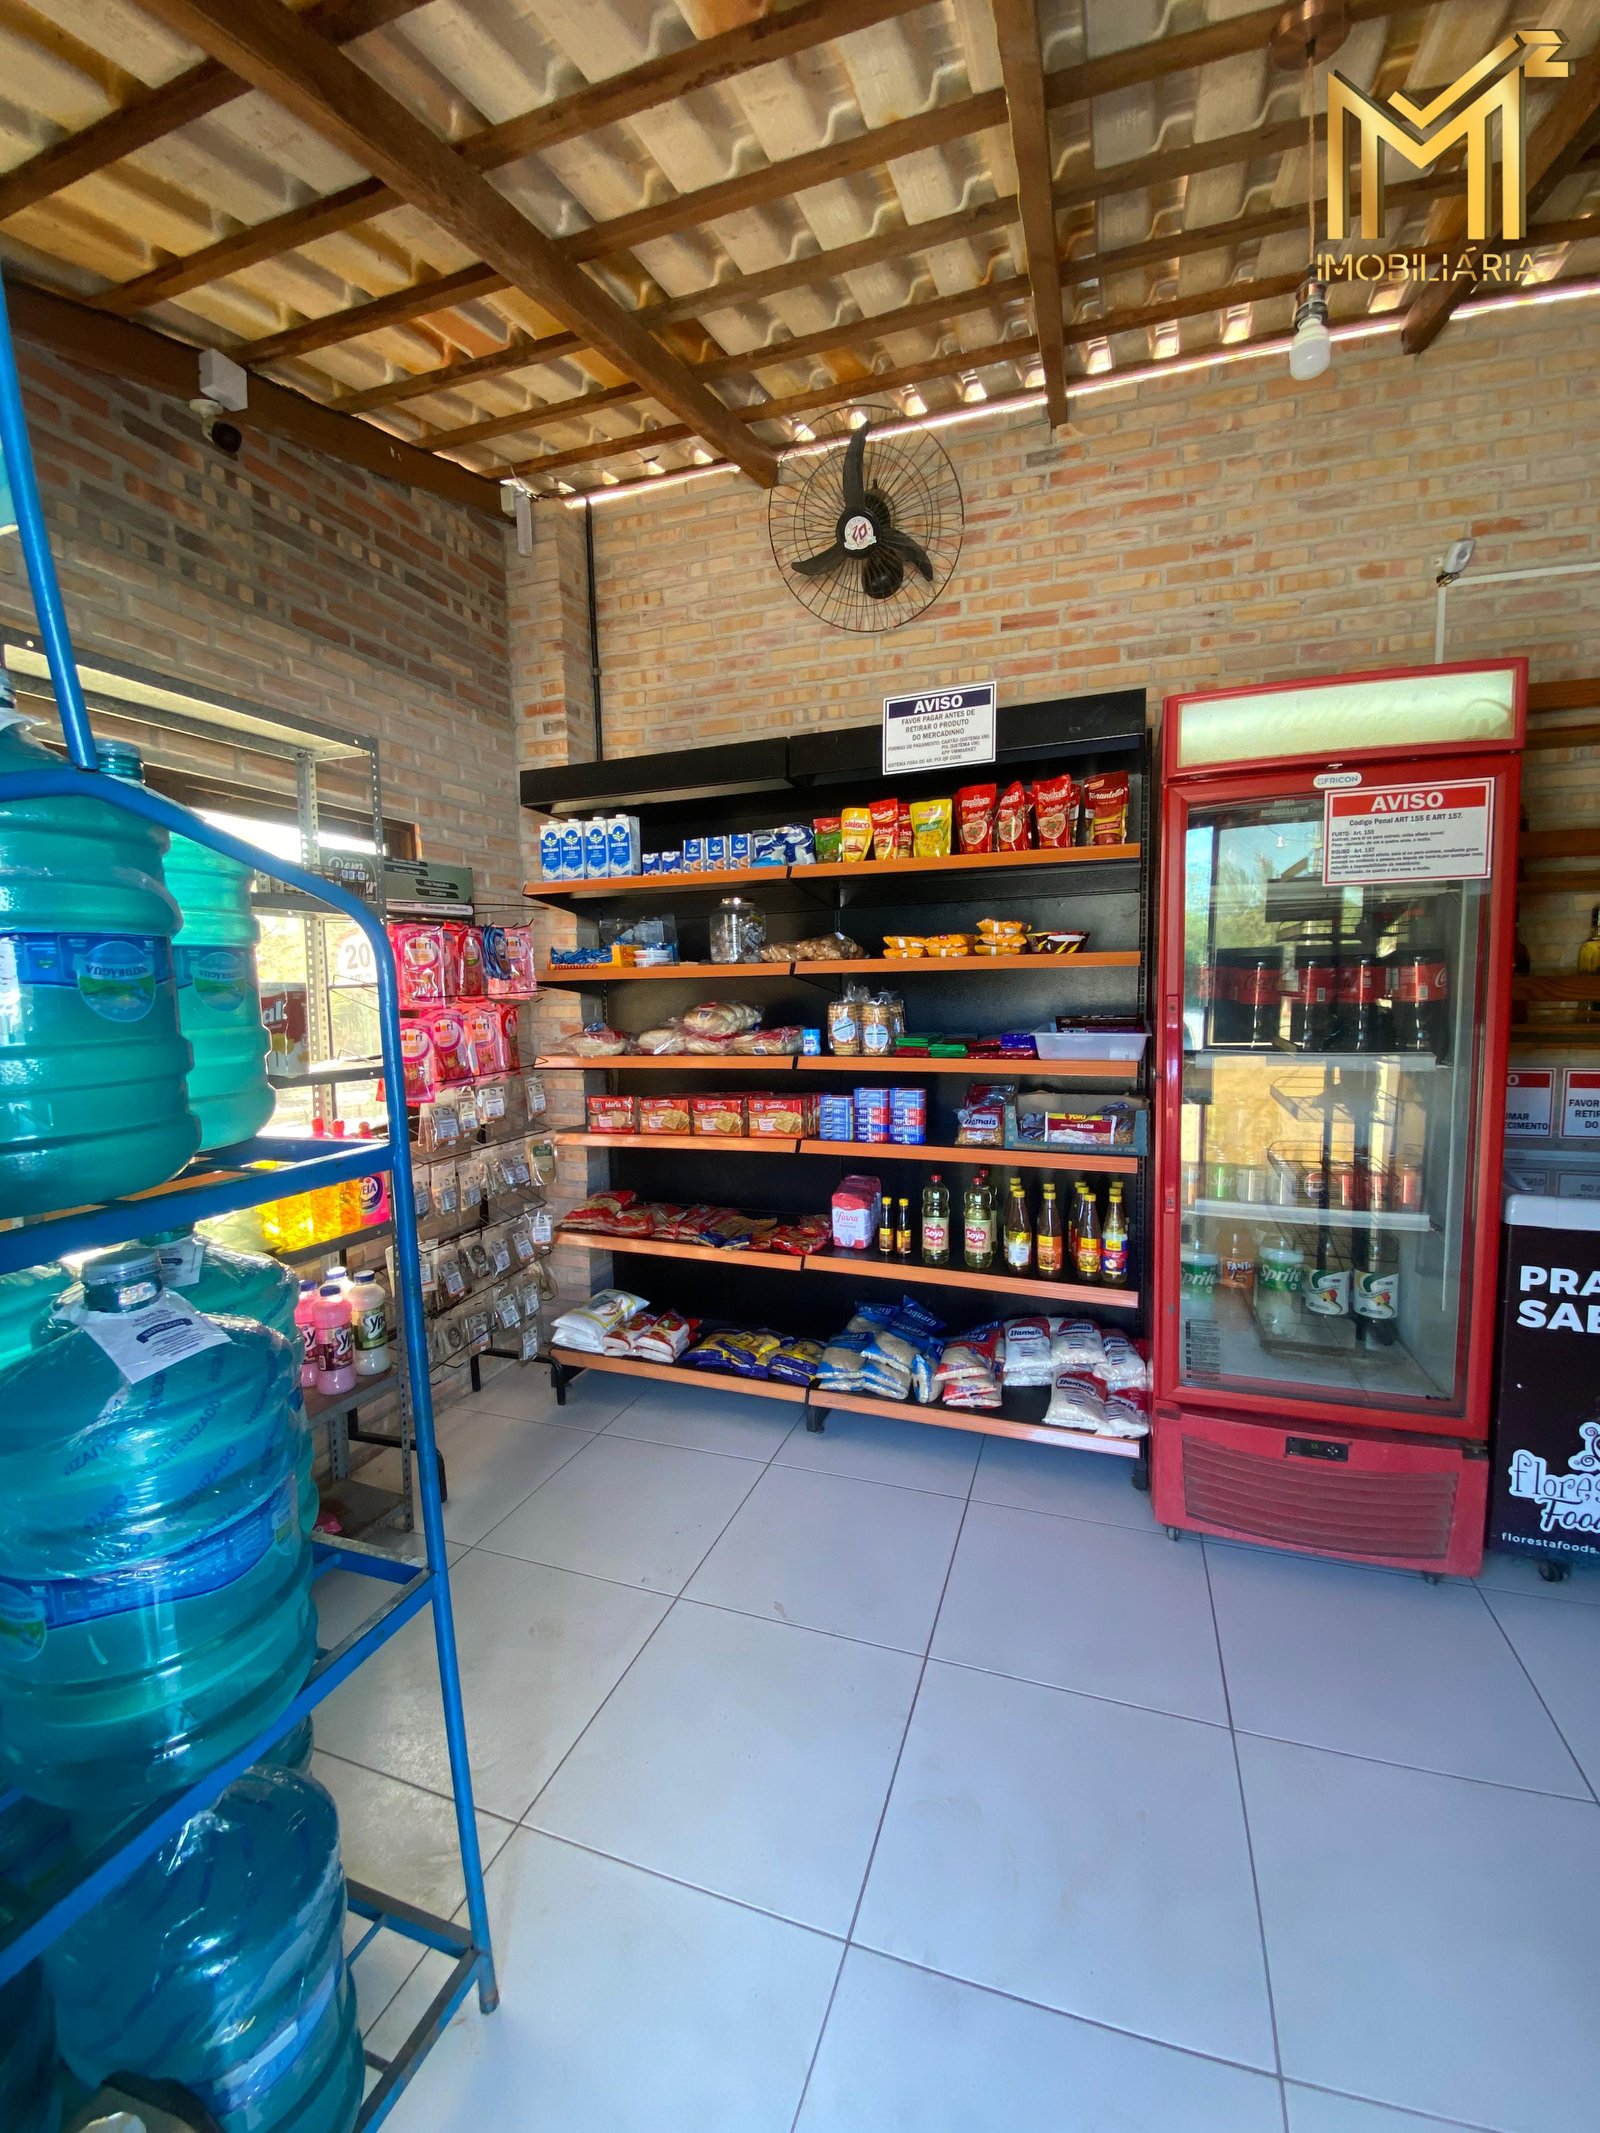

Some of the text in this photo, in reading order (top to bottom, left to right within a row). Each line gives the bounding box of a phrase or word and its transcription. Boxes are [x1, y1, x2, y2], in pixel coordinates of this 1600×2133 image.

[914, 695, 963, 714] AVISO
[901, 714, 921, 725] FAVOR
[922, 712, 943, 723] PAGAR
[944, 710, 965, 720] ANTES
[905, 718, 970, 733] RETIRAR O PRODUTO
[922, 728, 965, 740] MERCADINHO
[1324, 776, 1359, 785] FRICON
[1371, 791, 1444, 813] AVISO
[1349, 818, 1373, 827] Código
[1374, 817, 1393, 825] Penal
[1410, 814, 1424, 822] 155
[1431, 813, 1446, 821] ART
[345, 943, 371, 970] 20
[1568, 1099, 1600, 1107] FAVOR
[925, 1228, 944, 1238] Soya
[966, 1231, 985, 1240] Soya
